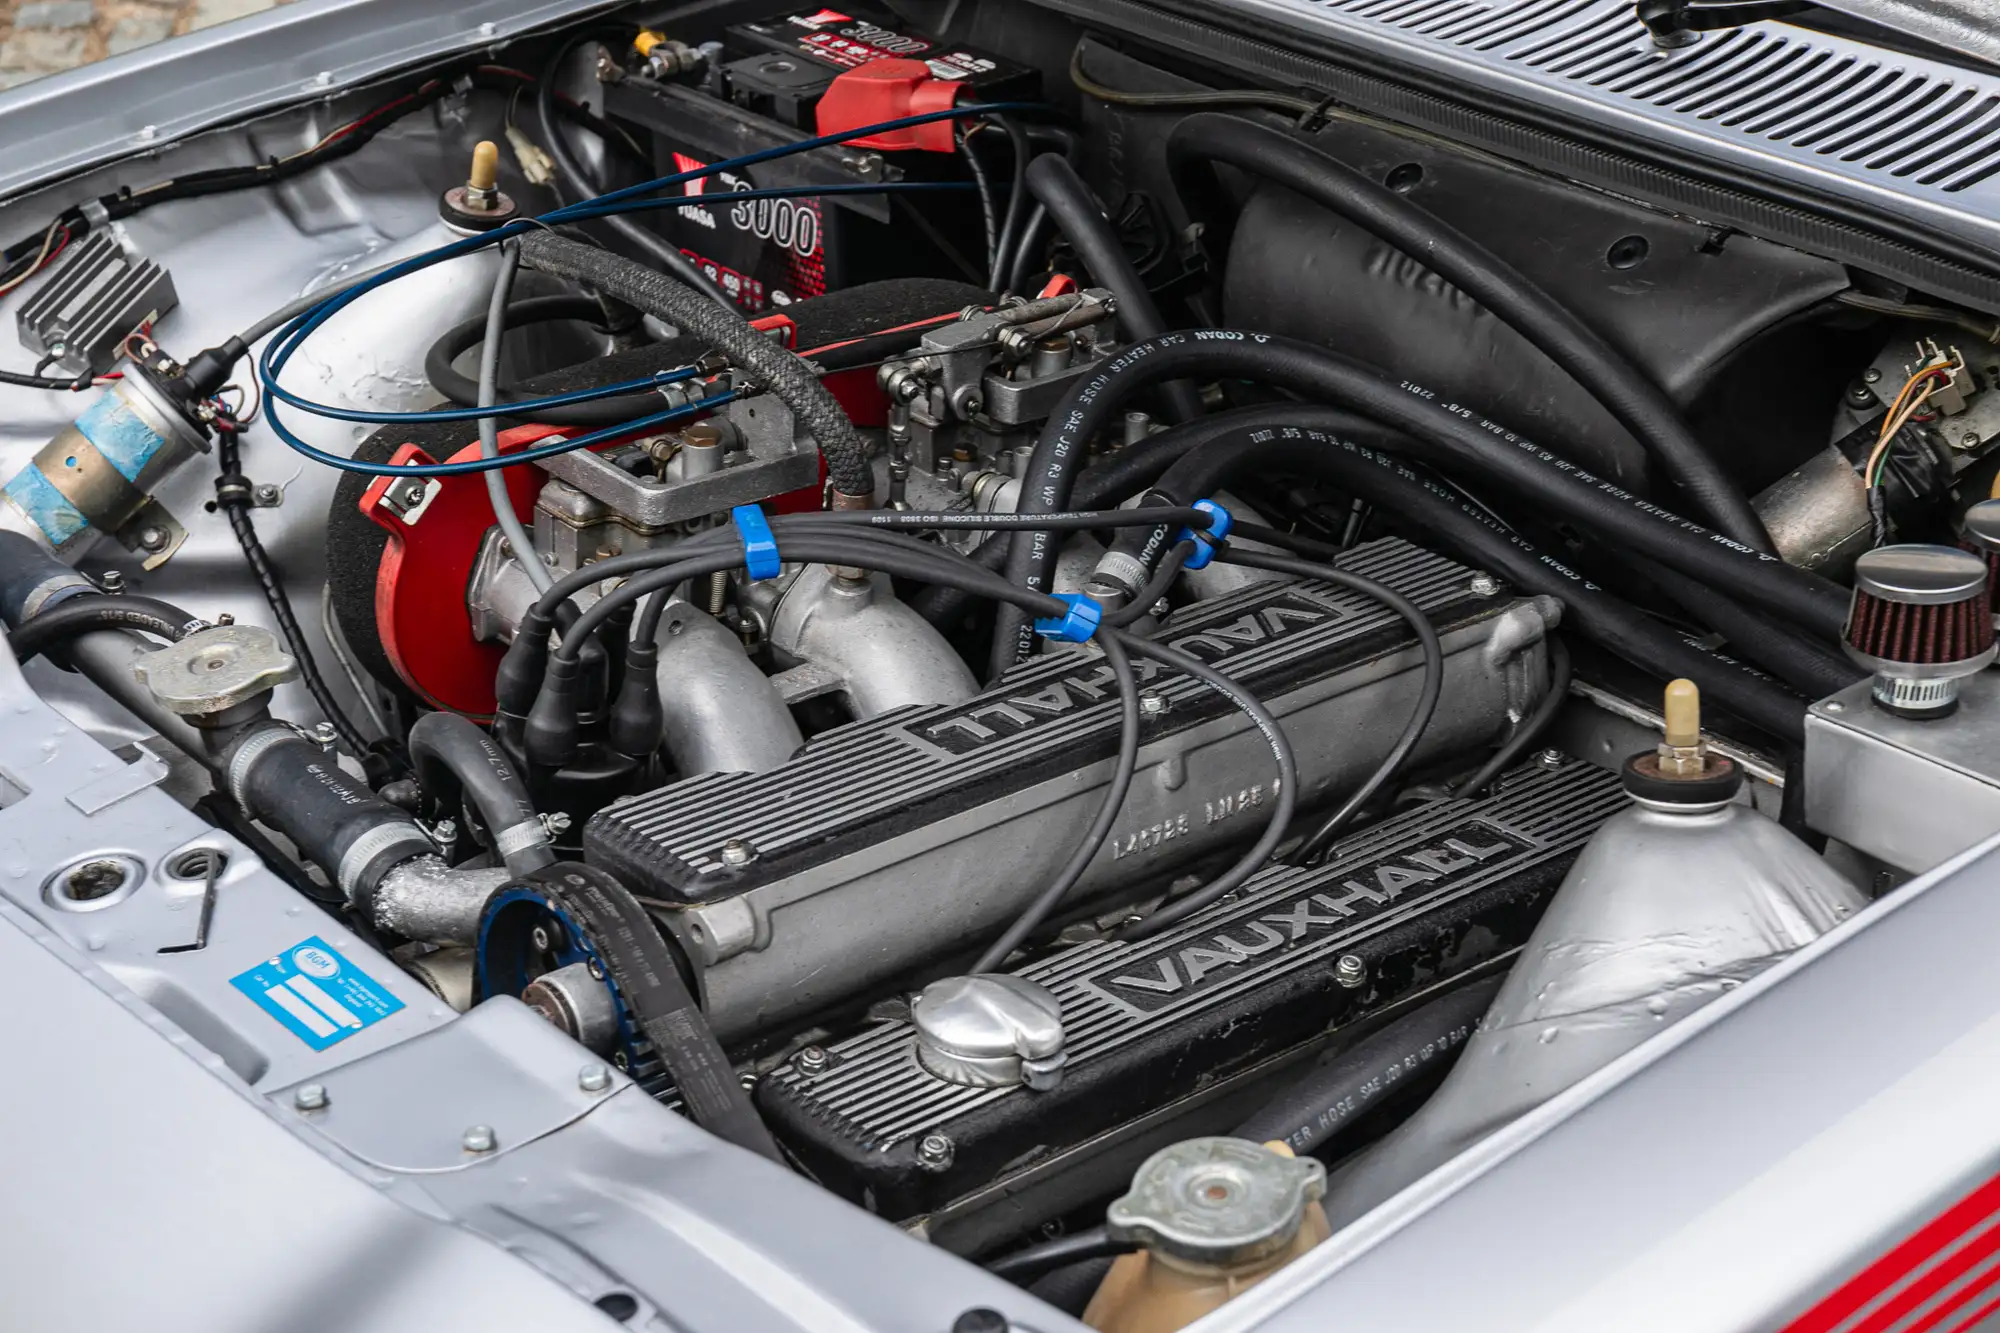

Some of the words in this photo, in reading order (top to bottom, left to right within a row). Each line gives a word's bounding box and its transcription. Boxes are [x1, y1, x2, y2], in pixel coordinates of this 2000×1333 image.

[731, 181, 817, 257] 3000
[1158, 333, 1186, 348] CAR
[1195, 330, 1245, 341] CODAN
[1109, 343, 1156, 373] HEATER
[1079, 374, 1111, 405] HOSE
[1064, 409, 1084, 433] SAE
[1480, 419, 1504, 435] BAR
[1054, 436, 1072, 458] J20
[1518, 441, 1539, 453] WP
[1538, 451, 1554, 461] R3
[1047, 462, 1062, 479] R3
[1574, 469, 1599, 483] SAE
[1041, 485, 1056, 506] WP
[1423, 480, 1457, 502] HOSE
[1598, 482, 1634, 500] HOSE
[941, 514, 981, 523] SILICONE
[983, 513, 1017, 522] DOUBLE
[1019, 510, 1079, 521] TEMPERATURE
[1461, 503, 1508, 534] HEATER
[1634, 500, 1680, 522] HEATER
[1680, 520, 1706, 534] CAR
[1032, 532, 1047, 560] BAR
[1510, 535, 1535, 552] CAR
[1709, 534, 1755, 554] CODAN
[1540, 555, 1582, 580] CODAN
[1015, 624, 1033, 663] 22012
[1111, 837, 1512, 994] VAUXHALL
[305, 950, 331, 970] BGM
[1284, 1125, 1312, 1149] TER
[1318, 1096, 1356, 1129] HOSE
[1359, 1076, 1382, 1100] SAE
